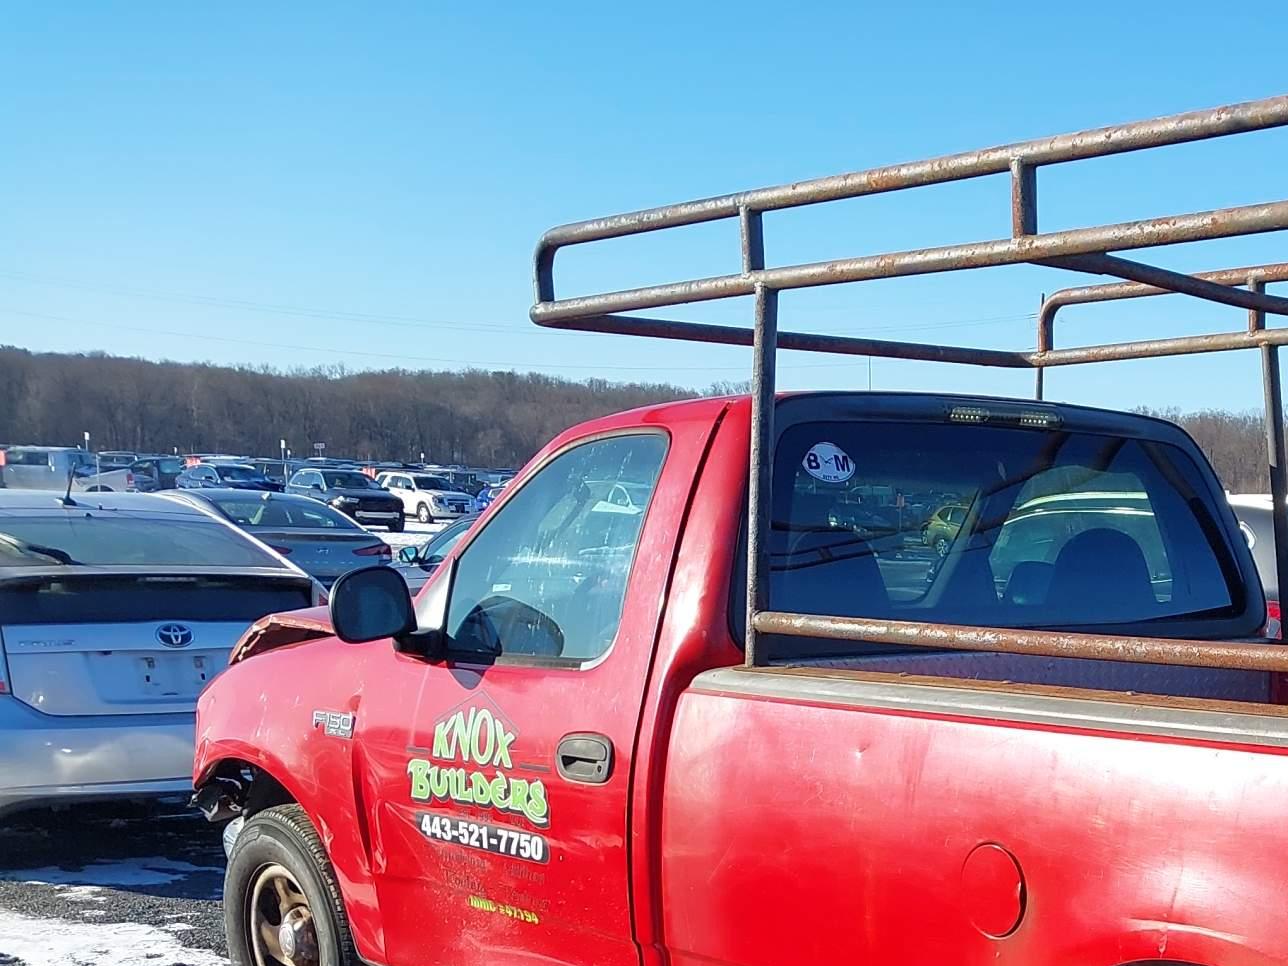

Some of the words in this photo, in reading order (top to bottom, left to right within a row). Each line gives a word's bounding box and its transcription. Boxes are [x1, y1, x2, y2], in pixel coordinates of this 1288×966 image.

[432, 707, 516, 769] KNOX
[407, 759, 549, 824] BUILDERS
[421, 814, 544, 861] 443-521-7750
